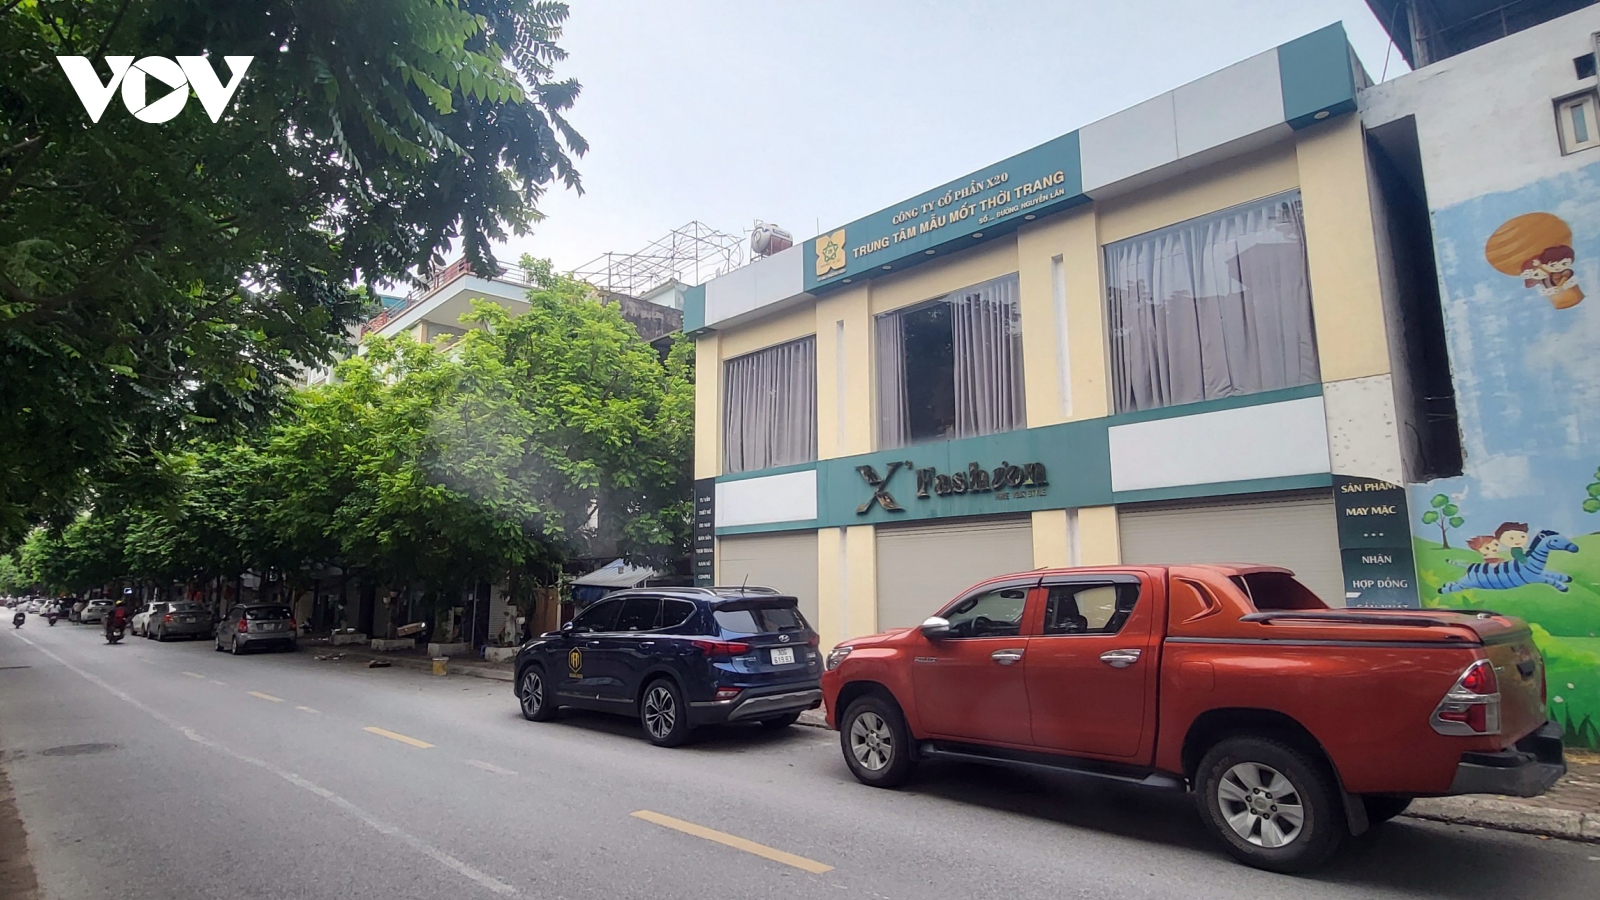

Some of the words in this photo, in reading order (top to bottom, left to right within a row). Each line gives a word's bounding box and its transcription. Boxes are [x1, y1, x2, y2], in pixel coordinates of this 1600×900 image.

[892, 207, 919, 225] CÔNG
[921, 201, 935, 214] TY
[937, 189, 952, 208] CỔ
[954, 179, 984, 201] PHẦN
[986, 172, 1009, 190] X20
[852, 236, 890, 259] TRUNG
[892, 226, 917, 244] TÂM
[920, 213, 946, 234] MẪU
[949, 202, 977, 223] MỐT
[979, 190, 1011, 213] THỜI
[1014, 170, 1065, 200] TRANG
[1341, 482, 1362, 493] SẢN
[1346, 507, 1369, 517] MAY
[1371, 504, 1397, 517] MẶC
[1362, 553, 1392, 566] NHẬN
[1352, 579, 1375, 590] HỢP
[1377, 576, 1408, 589] ĐỒNG
